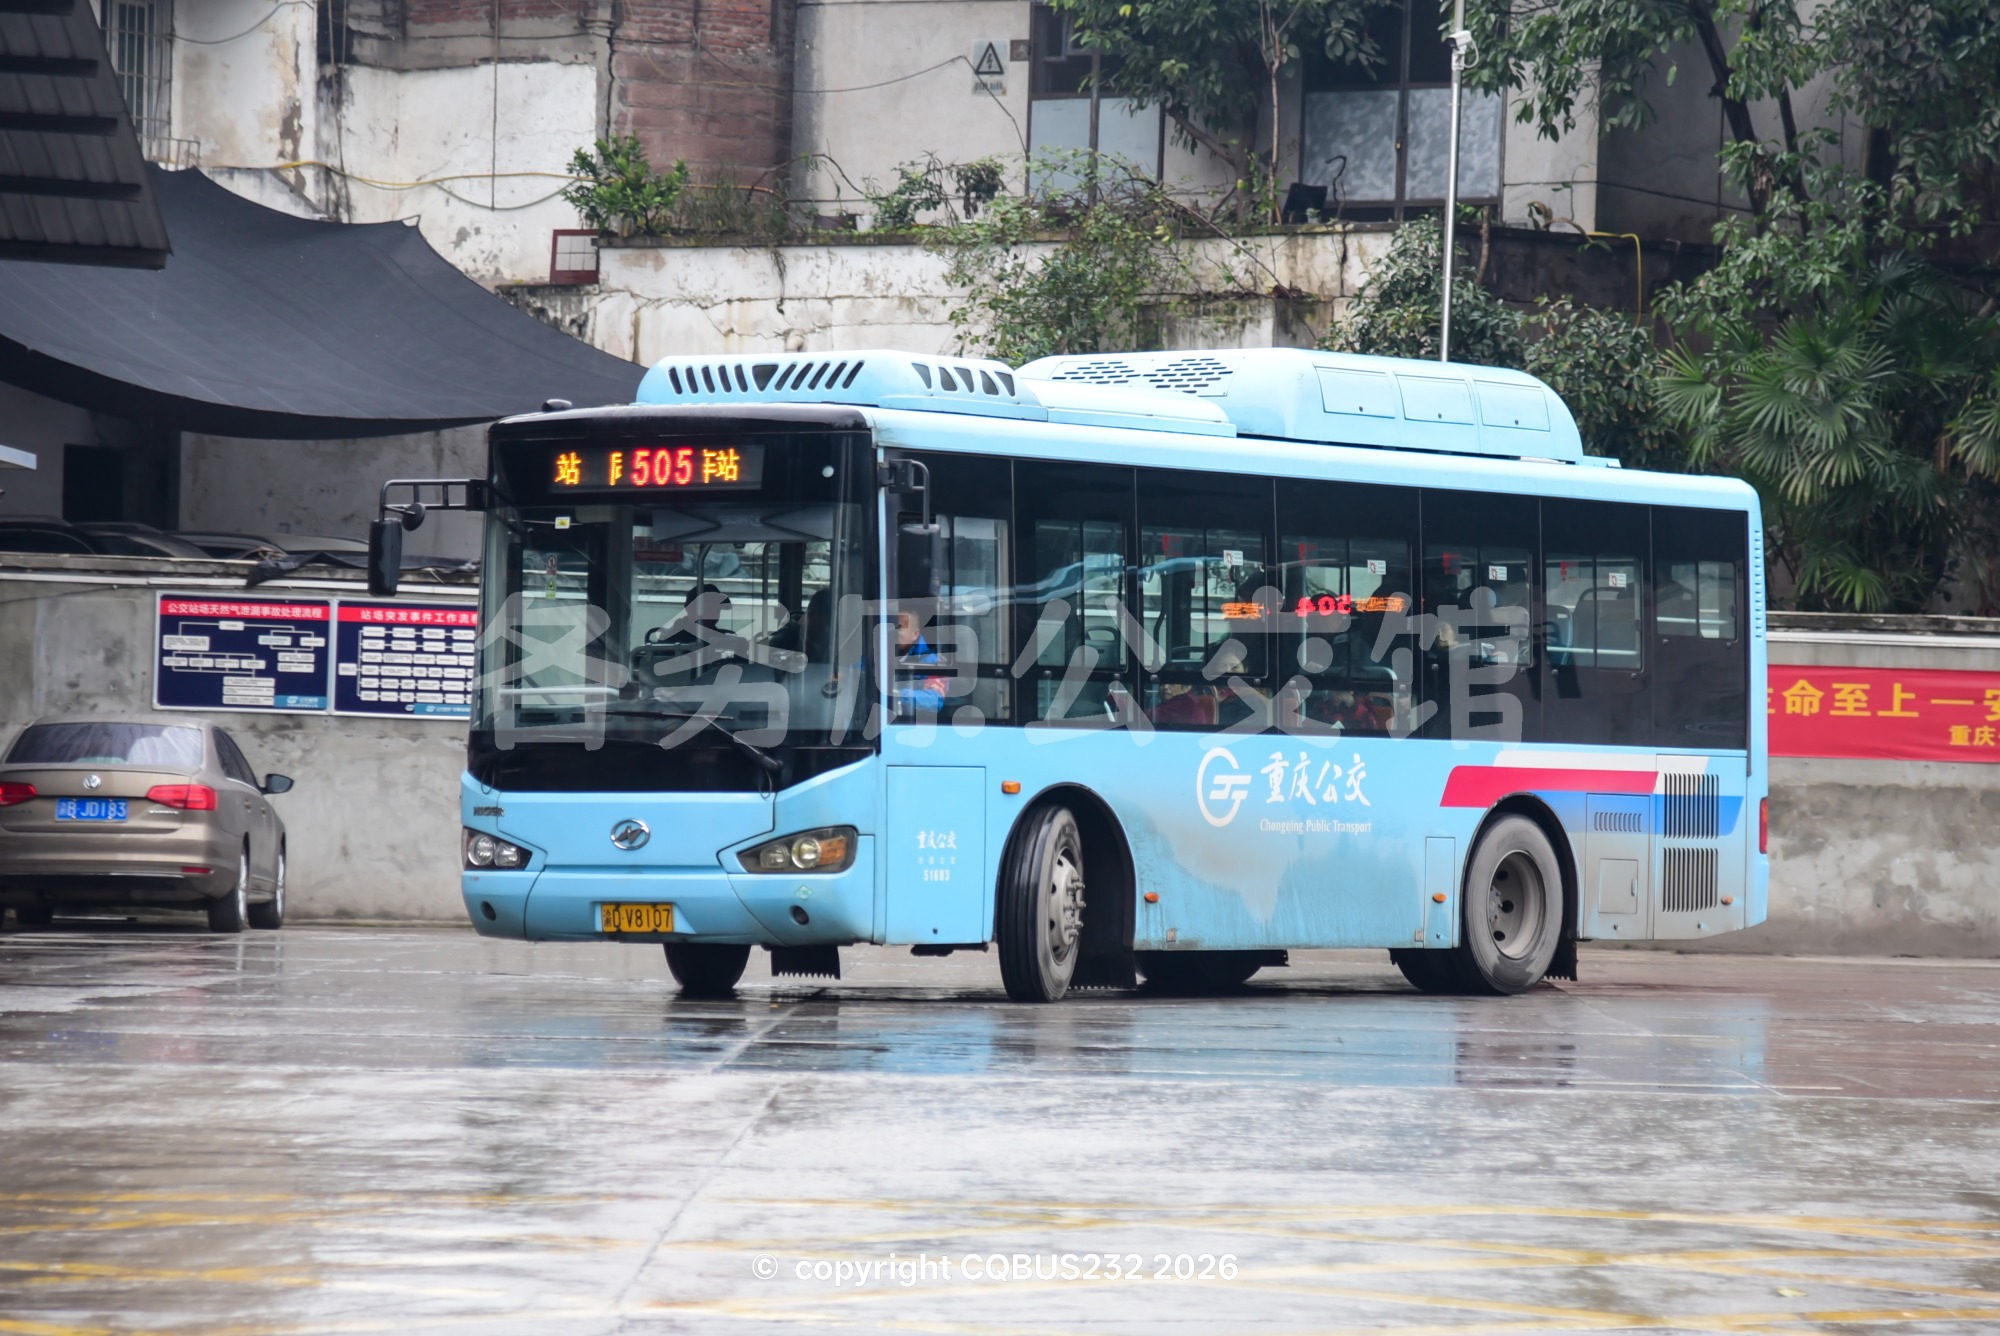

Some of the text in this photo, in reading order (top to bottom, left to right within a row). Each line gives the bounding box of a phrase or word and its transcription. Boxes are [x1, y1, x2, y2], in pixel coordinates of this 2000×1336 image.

[554, 451, 582, 485] 站
[631, 448, 694, 486] 505
[1948, 725, 2000, 747] 重庆
[1260, 751, 1371, 807] 重庆公交
[1260, 819, 1372, 834] Chongqing Public Transport
